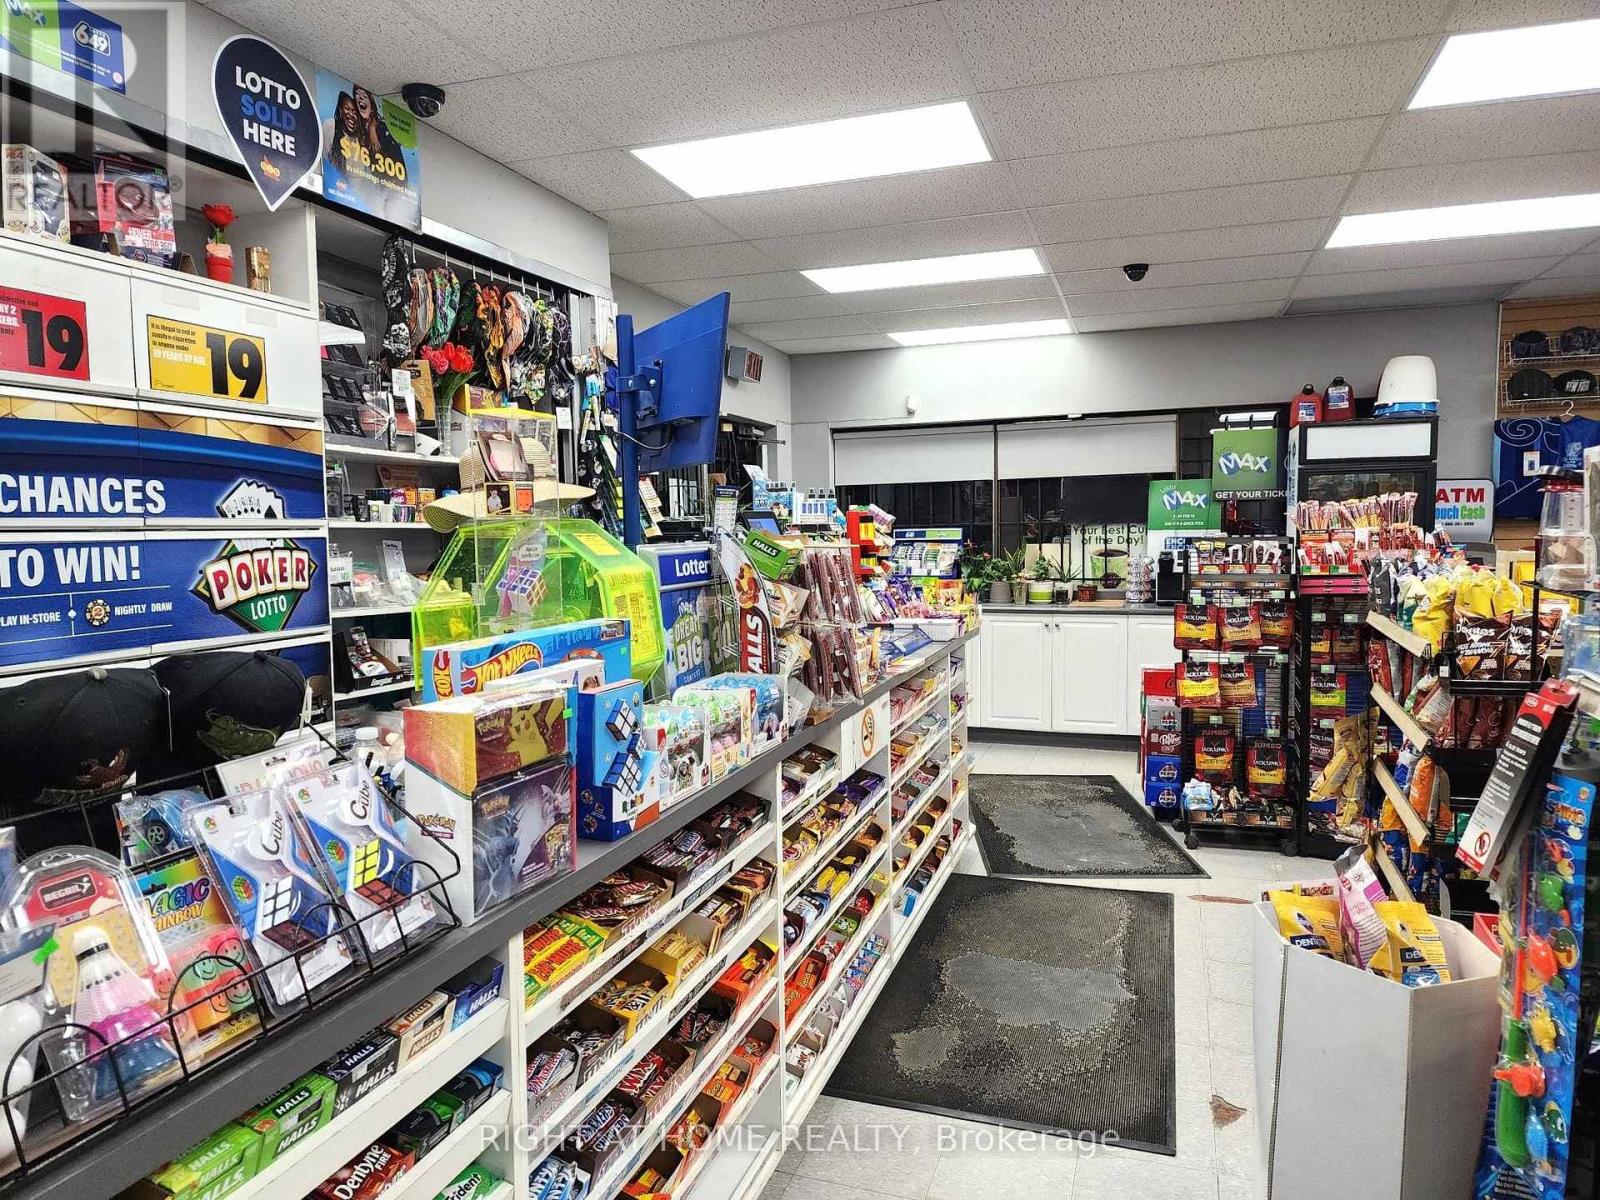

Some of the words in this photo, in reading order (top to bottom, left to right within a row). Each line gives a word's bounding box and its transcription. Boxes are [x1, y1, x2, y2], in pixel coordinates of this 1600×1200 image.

[235, 66, 301, 110] LOTTO
[241, 95, 296, 131] SOLD
[243, 119, 296, 156] HERE
[22, 308, 83, 371] 19
[206, 331, 264, 400] 19
[0, 475, 166, 514] CHANCES
[1216, 491, 1233, 500] GET
[1235, 490, 1262, 499] YOUR
[1434, 488, 1485, 503] ATM
[1435, 505, 1459, 520] ouch
[1461, 504, 1485, 520] Cash
[1073, 525, 1098, 536] Your
[1095, 535, 1113, 545] the
[752, 540, 779, 557] HALLS
[0, 547, 44, 588] TO
[54, 545, 140, 586] WIN!
[213, 556, 307, 601] POKER
[0, 614, 19, 627] LAY
[19, 611, 61, 625] IN-STORE
[114, 603, 147, 616] NIGHTLY
[151, 602, 172, 613] DRAW
[251, 596, 287, 620] LOTTO
[746, 613, 764, 675] ALLS
[1456, 623, 1496, 636] Doritos
[676, 635, 702, 672] BIG
[351, 780, 371, 820] Cube
[262, 810, 284, 856] Cube
[153, 902, 205, 931] AINBOW
[406, 1001, 433, 1023] HALLS
[469, 985, 498, 1014] HALLS
[344, 1044, 376, 1067] HALLS
[410, 1023, 443, 1059] HALLS
[355, 1060, 396, 1098] HALLS
[617, 1058, 656, 1096] TWIX
[275, 1088, 310, 1117] HALLS
[278, 1115, 318, 1154] HALLS
[579, 1103, 615, 1142] SNICKERS
[188, 1141, 231, 1173] HALLS
[333, 1144, 386, 1200] Dentyne
[375, 1151, 392, 1172] FIRE
[201, 1168, 246, 1200] ALLS
